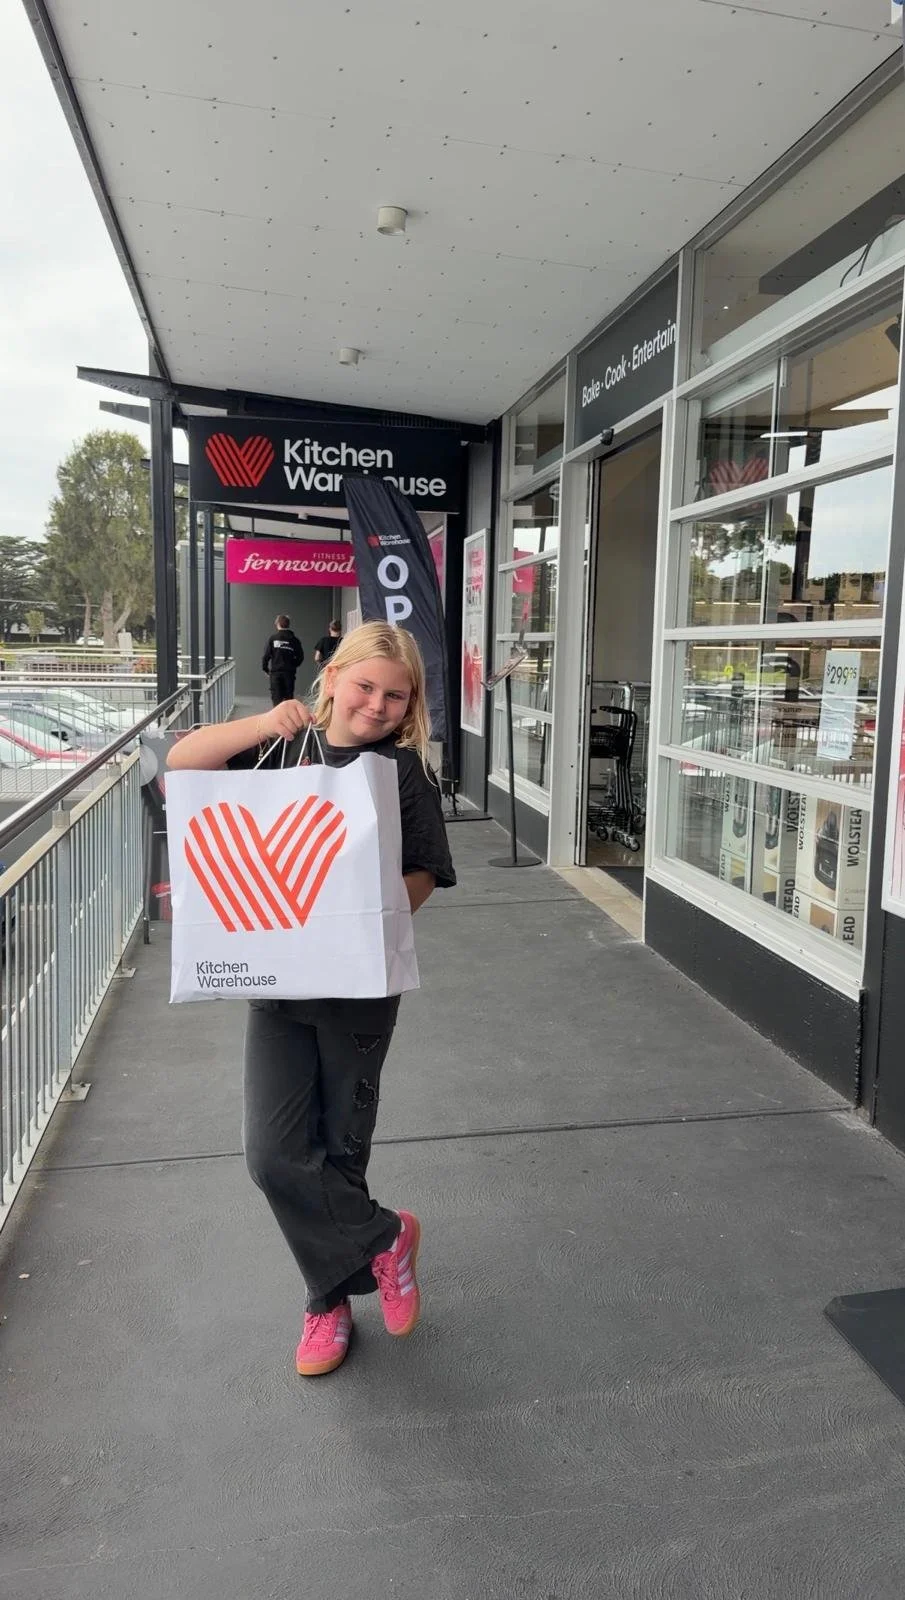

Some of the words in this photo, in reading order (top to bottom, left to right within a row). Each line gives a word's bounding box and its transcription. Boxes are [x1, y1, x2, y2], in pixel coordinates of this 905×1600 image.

[582, 379, 600, 408] Bake
[604, 354, 627, 390] Cook
[632, 319, 677, 371] Entertain
[283, 438, 394, 469] Kitchen
[283, 465, 447, 497] Waruse
[238, 552, 355, 574] fernwood
[313, 552, 346, 561] FITNESS
[196, 960, 249, 974] Kitchen
[197, 975, 277, 988] Warehouse
